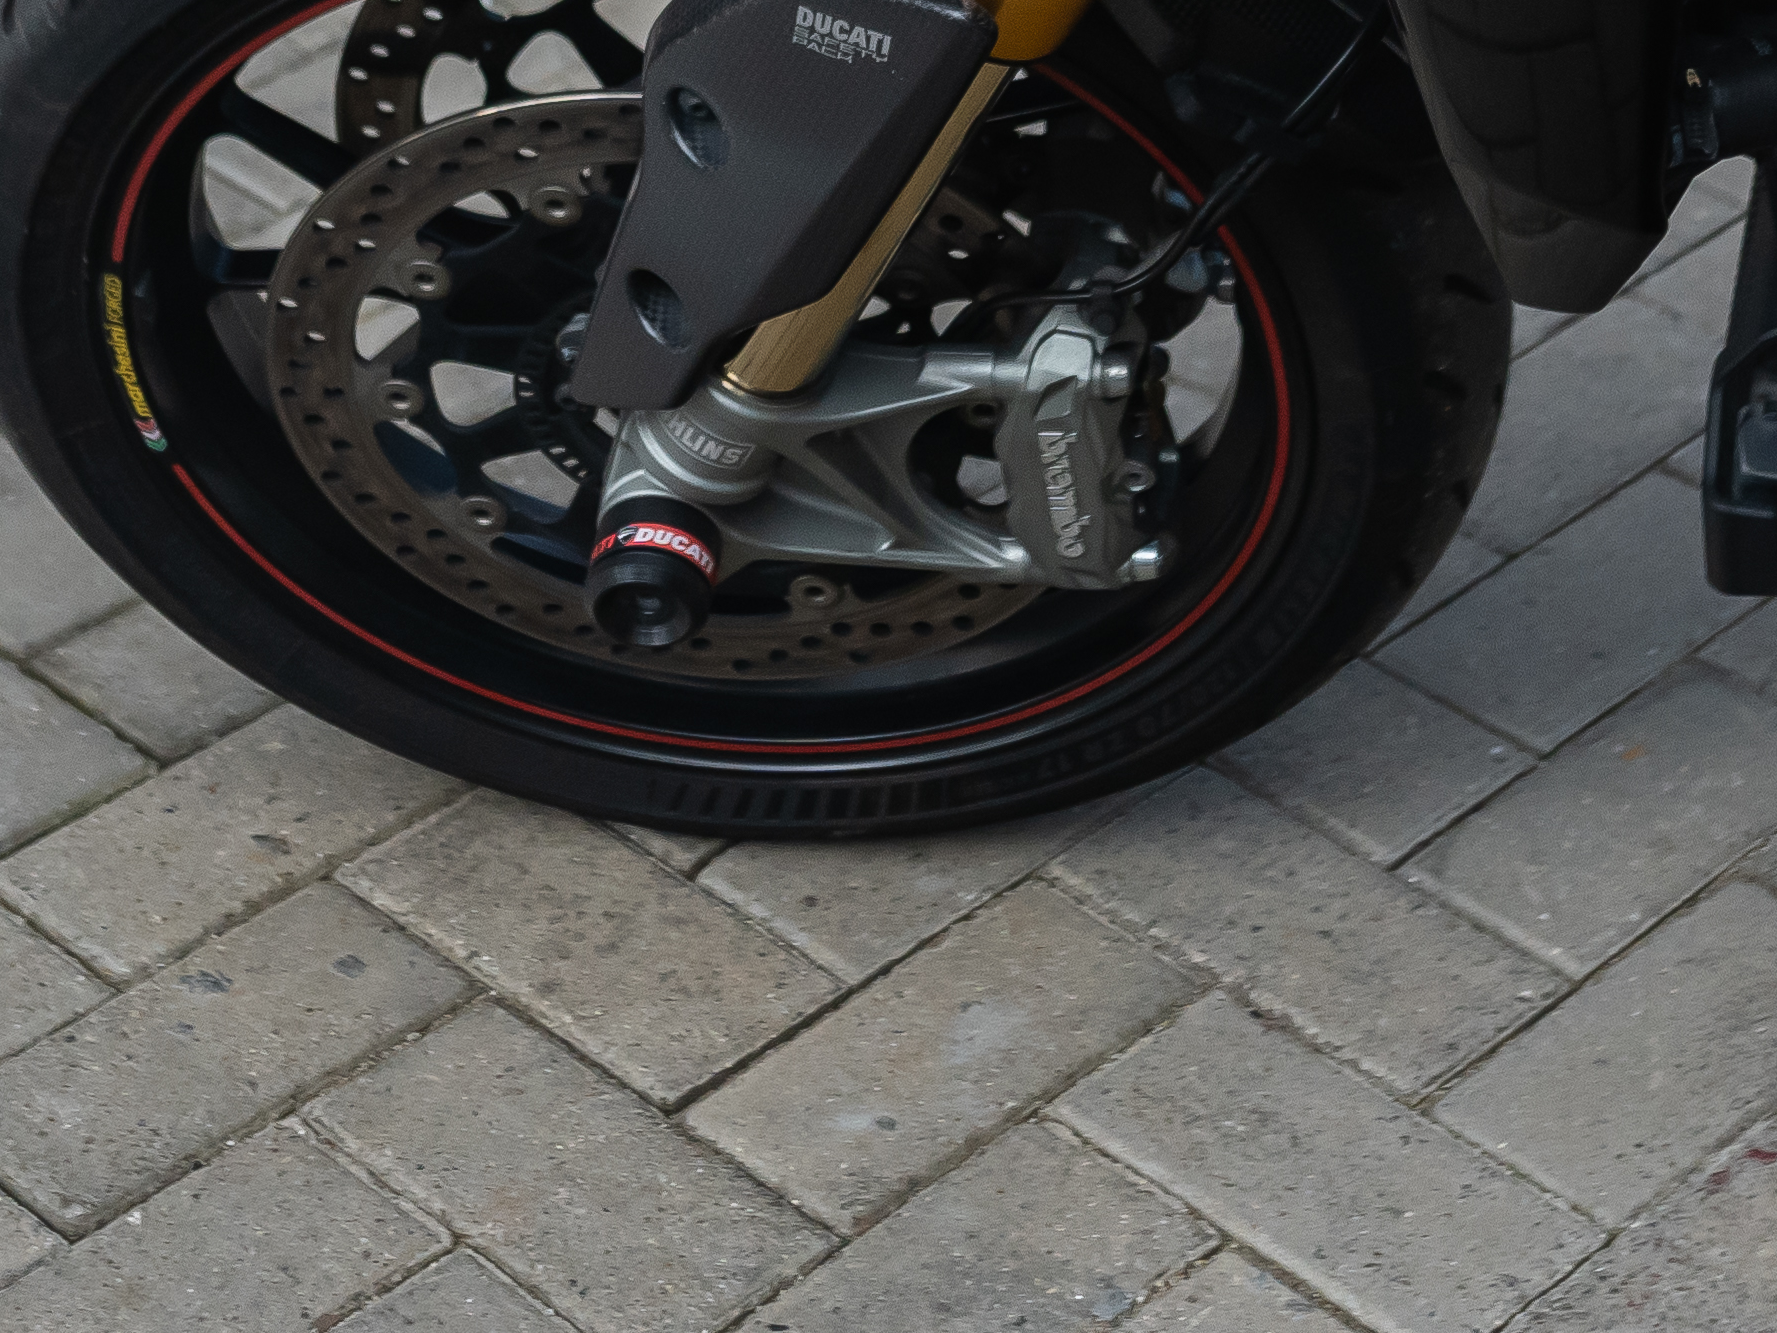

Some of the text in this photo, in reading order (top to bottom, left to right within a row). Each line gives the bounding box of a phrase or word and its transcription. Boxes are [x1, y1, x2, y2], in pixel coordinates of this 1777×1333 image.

[795, 5, 892, 55] DUCATI
[666, 415, 745, 466] HLINS
[1037, 432, 1092, 559] brembo
[632, 527, 715, 576] DUCATI
